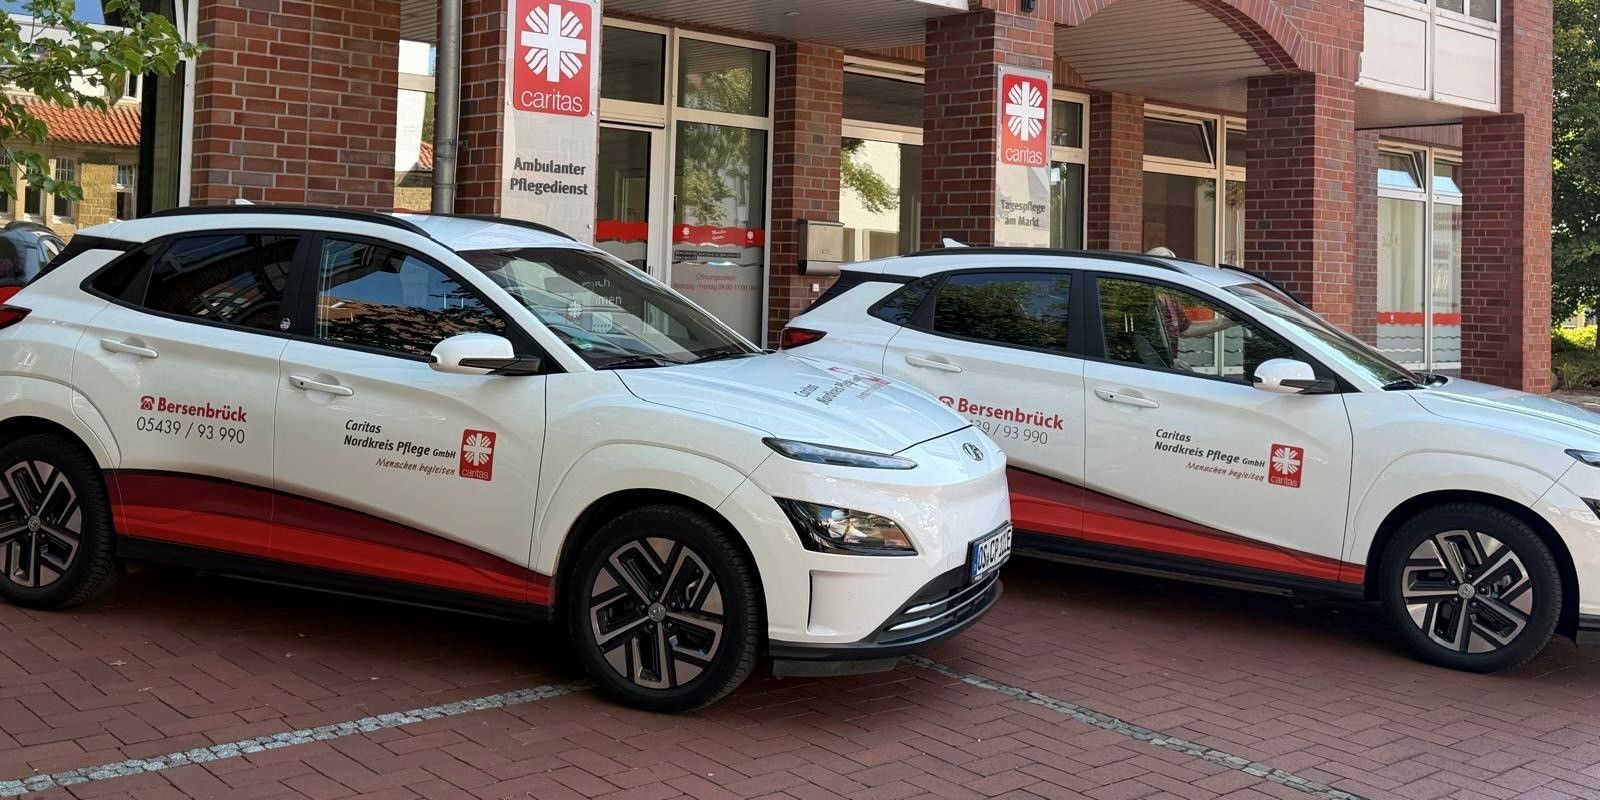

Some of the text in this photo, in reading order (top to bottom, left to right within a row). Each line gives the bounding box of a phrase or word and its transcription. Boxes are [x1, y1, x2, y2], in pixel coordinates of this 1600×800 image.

[521, 89, 583, 113] caritas
[1005, 145, 1043, 165] caritas
[514, 157, 587, 176] Ambulanter
[510, 178, 588, 196] Pflegedienst
[1000, 199, 1046, 214] Tagespflege
[1004, 216, 1039, 227] am Markt
[157, 396, 248, 423] Bersenbrück
[957, 397, 1065, 431] Bersenbrück
[136, 416, 245, 444] 05439 / 93 990
[345, 419, 382, 434] Caritas
[1003, 425, 1019, 440] 93
[1023, 429, 1048, 445] 990
[1155, 428, 1192, 443] Caritas
[343, 435, 456, 459] Nordkreis Pflege GmbH
[1154, 441, 1266, 468] Nordkreis Pflege GmbH
[375, 458, 456, 476] Menschen begleiten
[461, 468, 490, 480] caritas
[1186, 462, 1265, 482] Menschen begleiten
[1270, 475, 1298, 487] caritas
